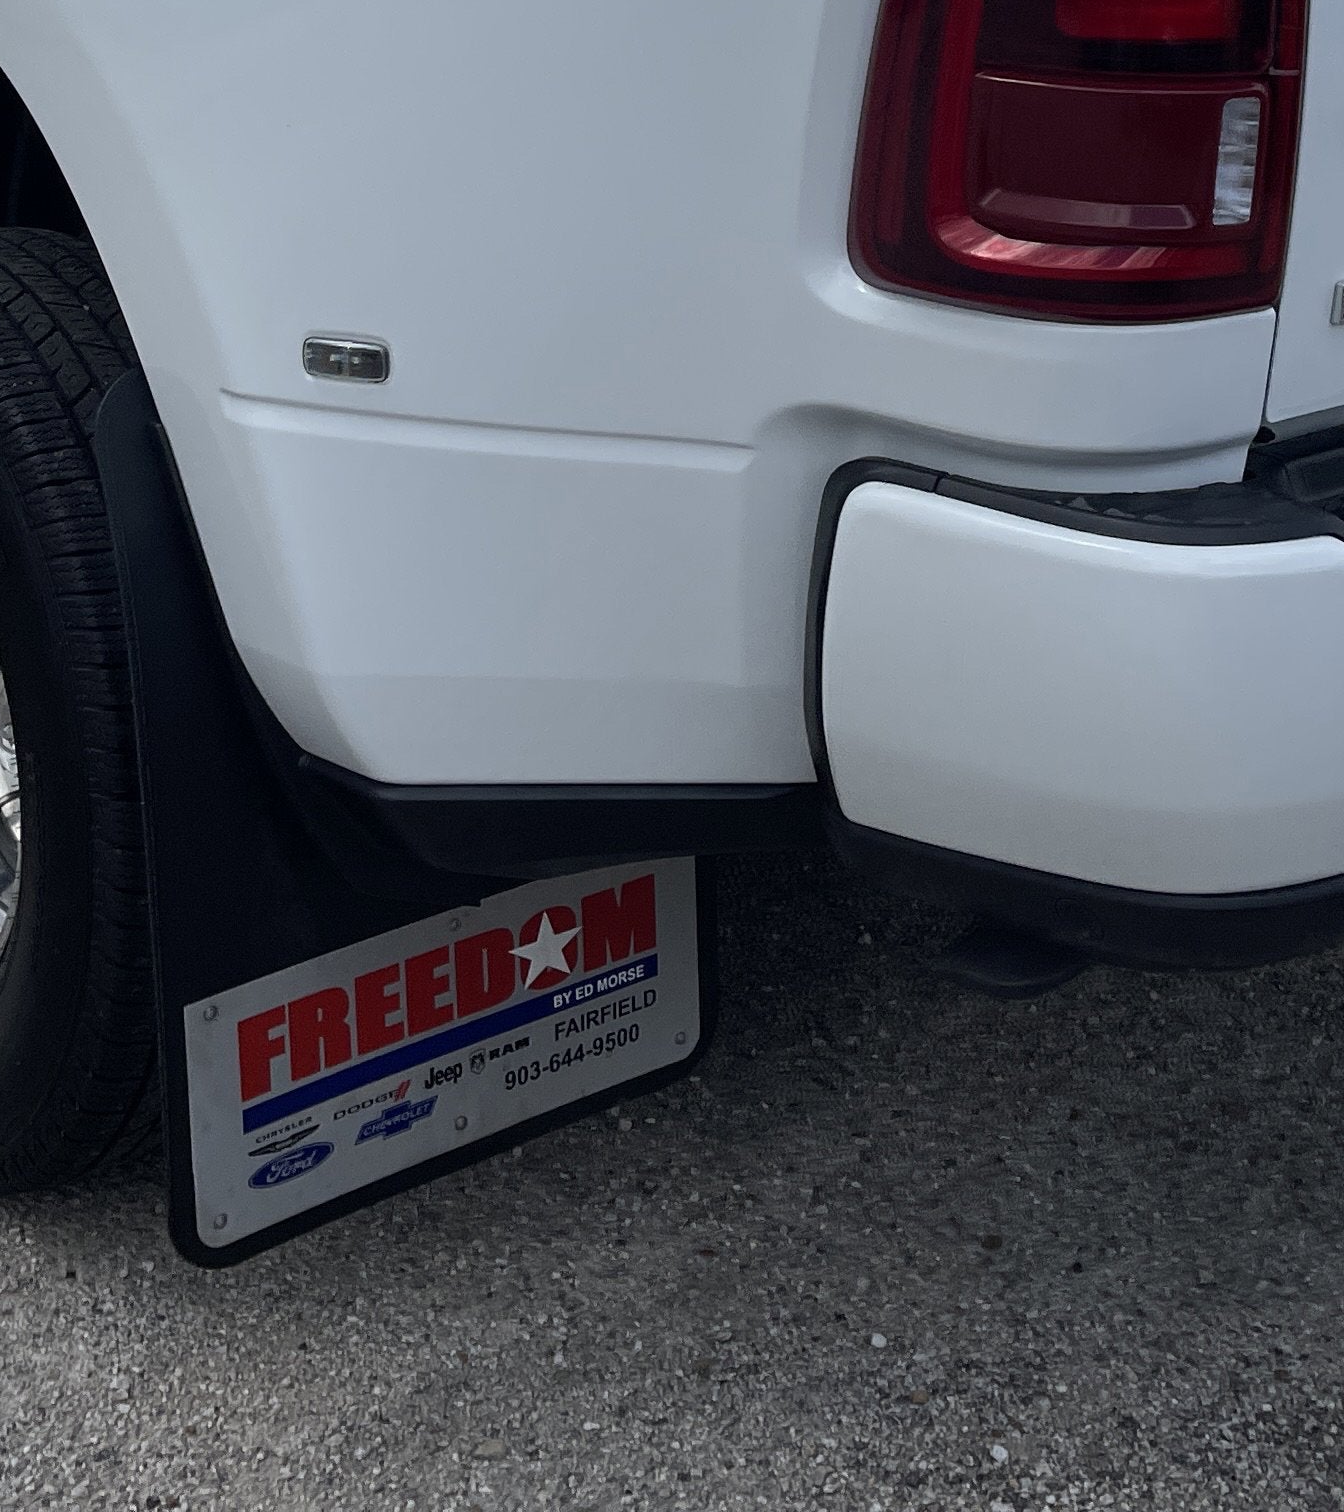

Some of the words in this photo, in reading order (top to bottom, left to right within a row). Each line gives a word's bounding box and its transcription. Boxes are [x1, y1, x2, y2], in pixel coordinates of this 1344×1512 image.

[237, 873, 657, 1102] FREEDOM
[553, 990, 573, 1008] BY
[575, 983, 594, 1000] ED
[597, 964, 645, 993] MORSE
[554, 989, 657, 1042] FAIRFIELD
[489, 1036, 531, 1062] RAM
[505, 1022, 640, 1091] 903-644-9500
[424, 1062, 463, 1090] Jeep
[255, 1115, 313, 1144] CHRYSLER
[363, 1102, 432, 1137] CHEVROLET
[266, 1149, 317, 1183] Ford
